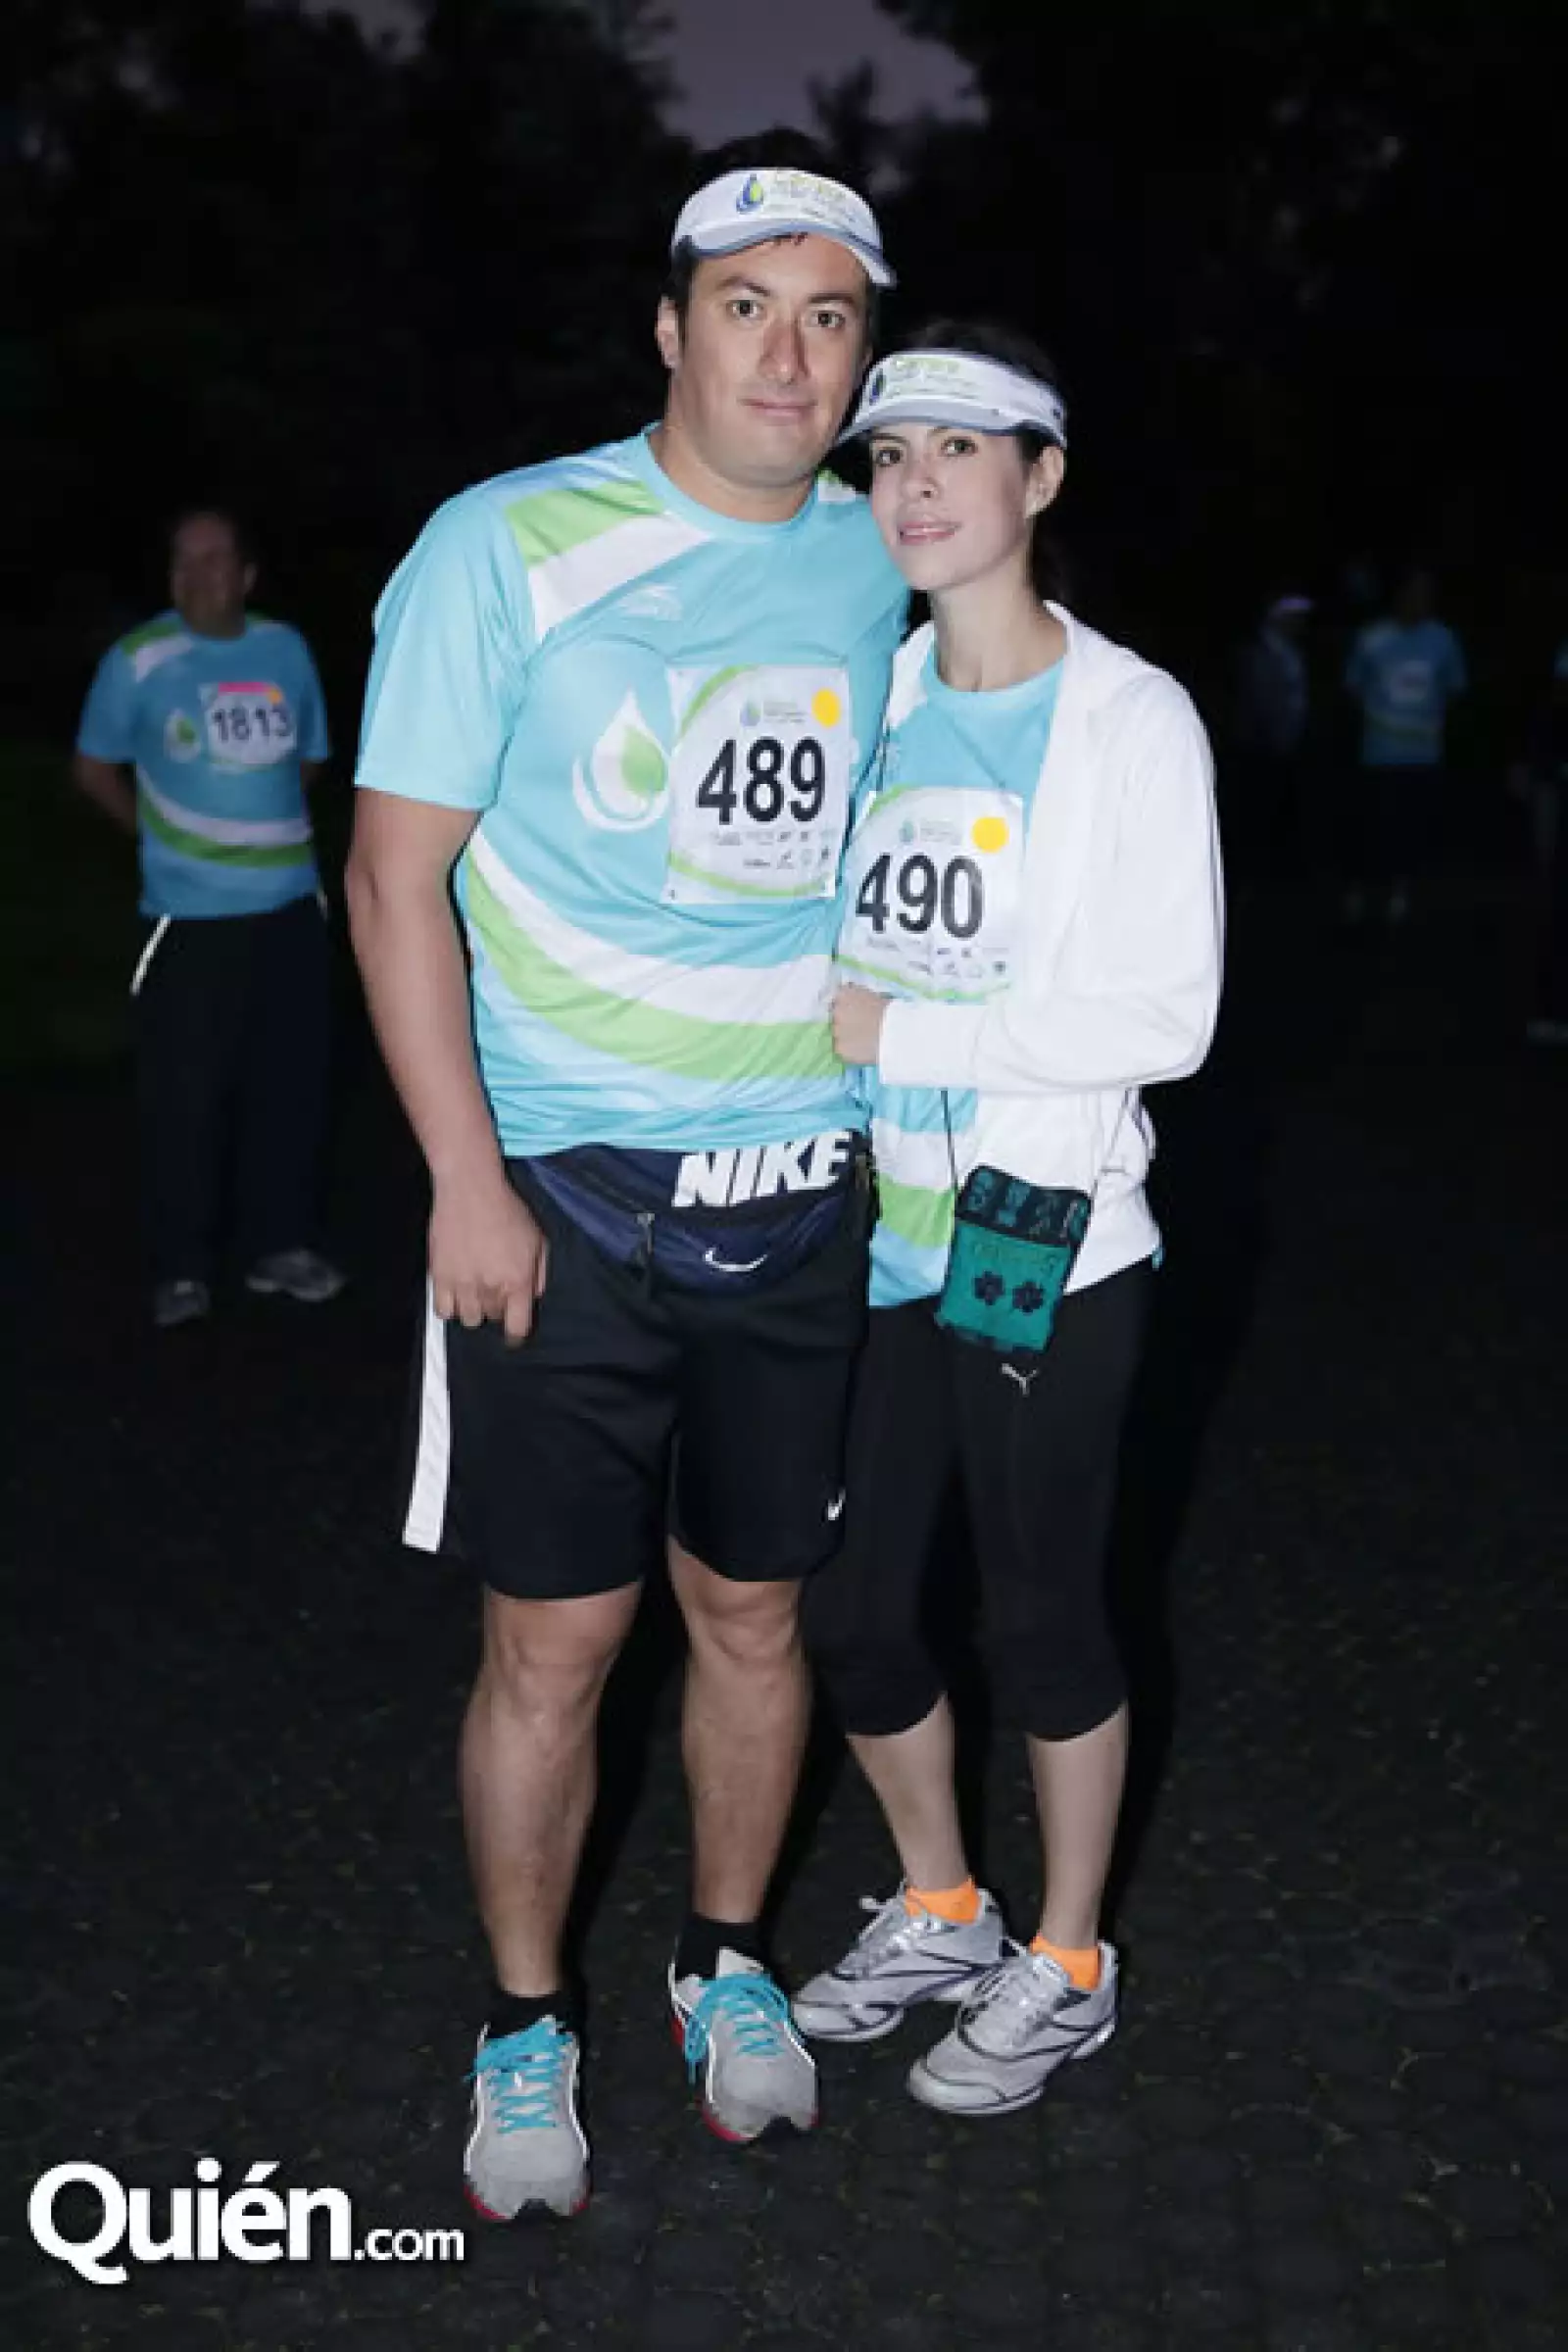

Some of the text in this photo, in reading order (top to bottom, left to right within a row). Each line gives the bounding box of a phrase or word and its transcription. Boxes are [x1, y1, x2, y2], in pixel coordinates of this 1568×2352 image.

[696, 736, 826, 825] 489
[856, 853, 985, 940] 490
[671, 1130, 851, 1207] NIKE
